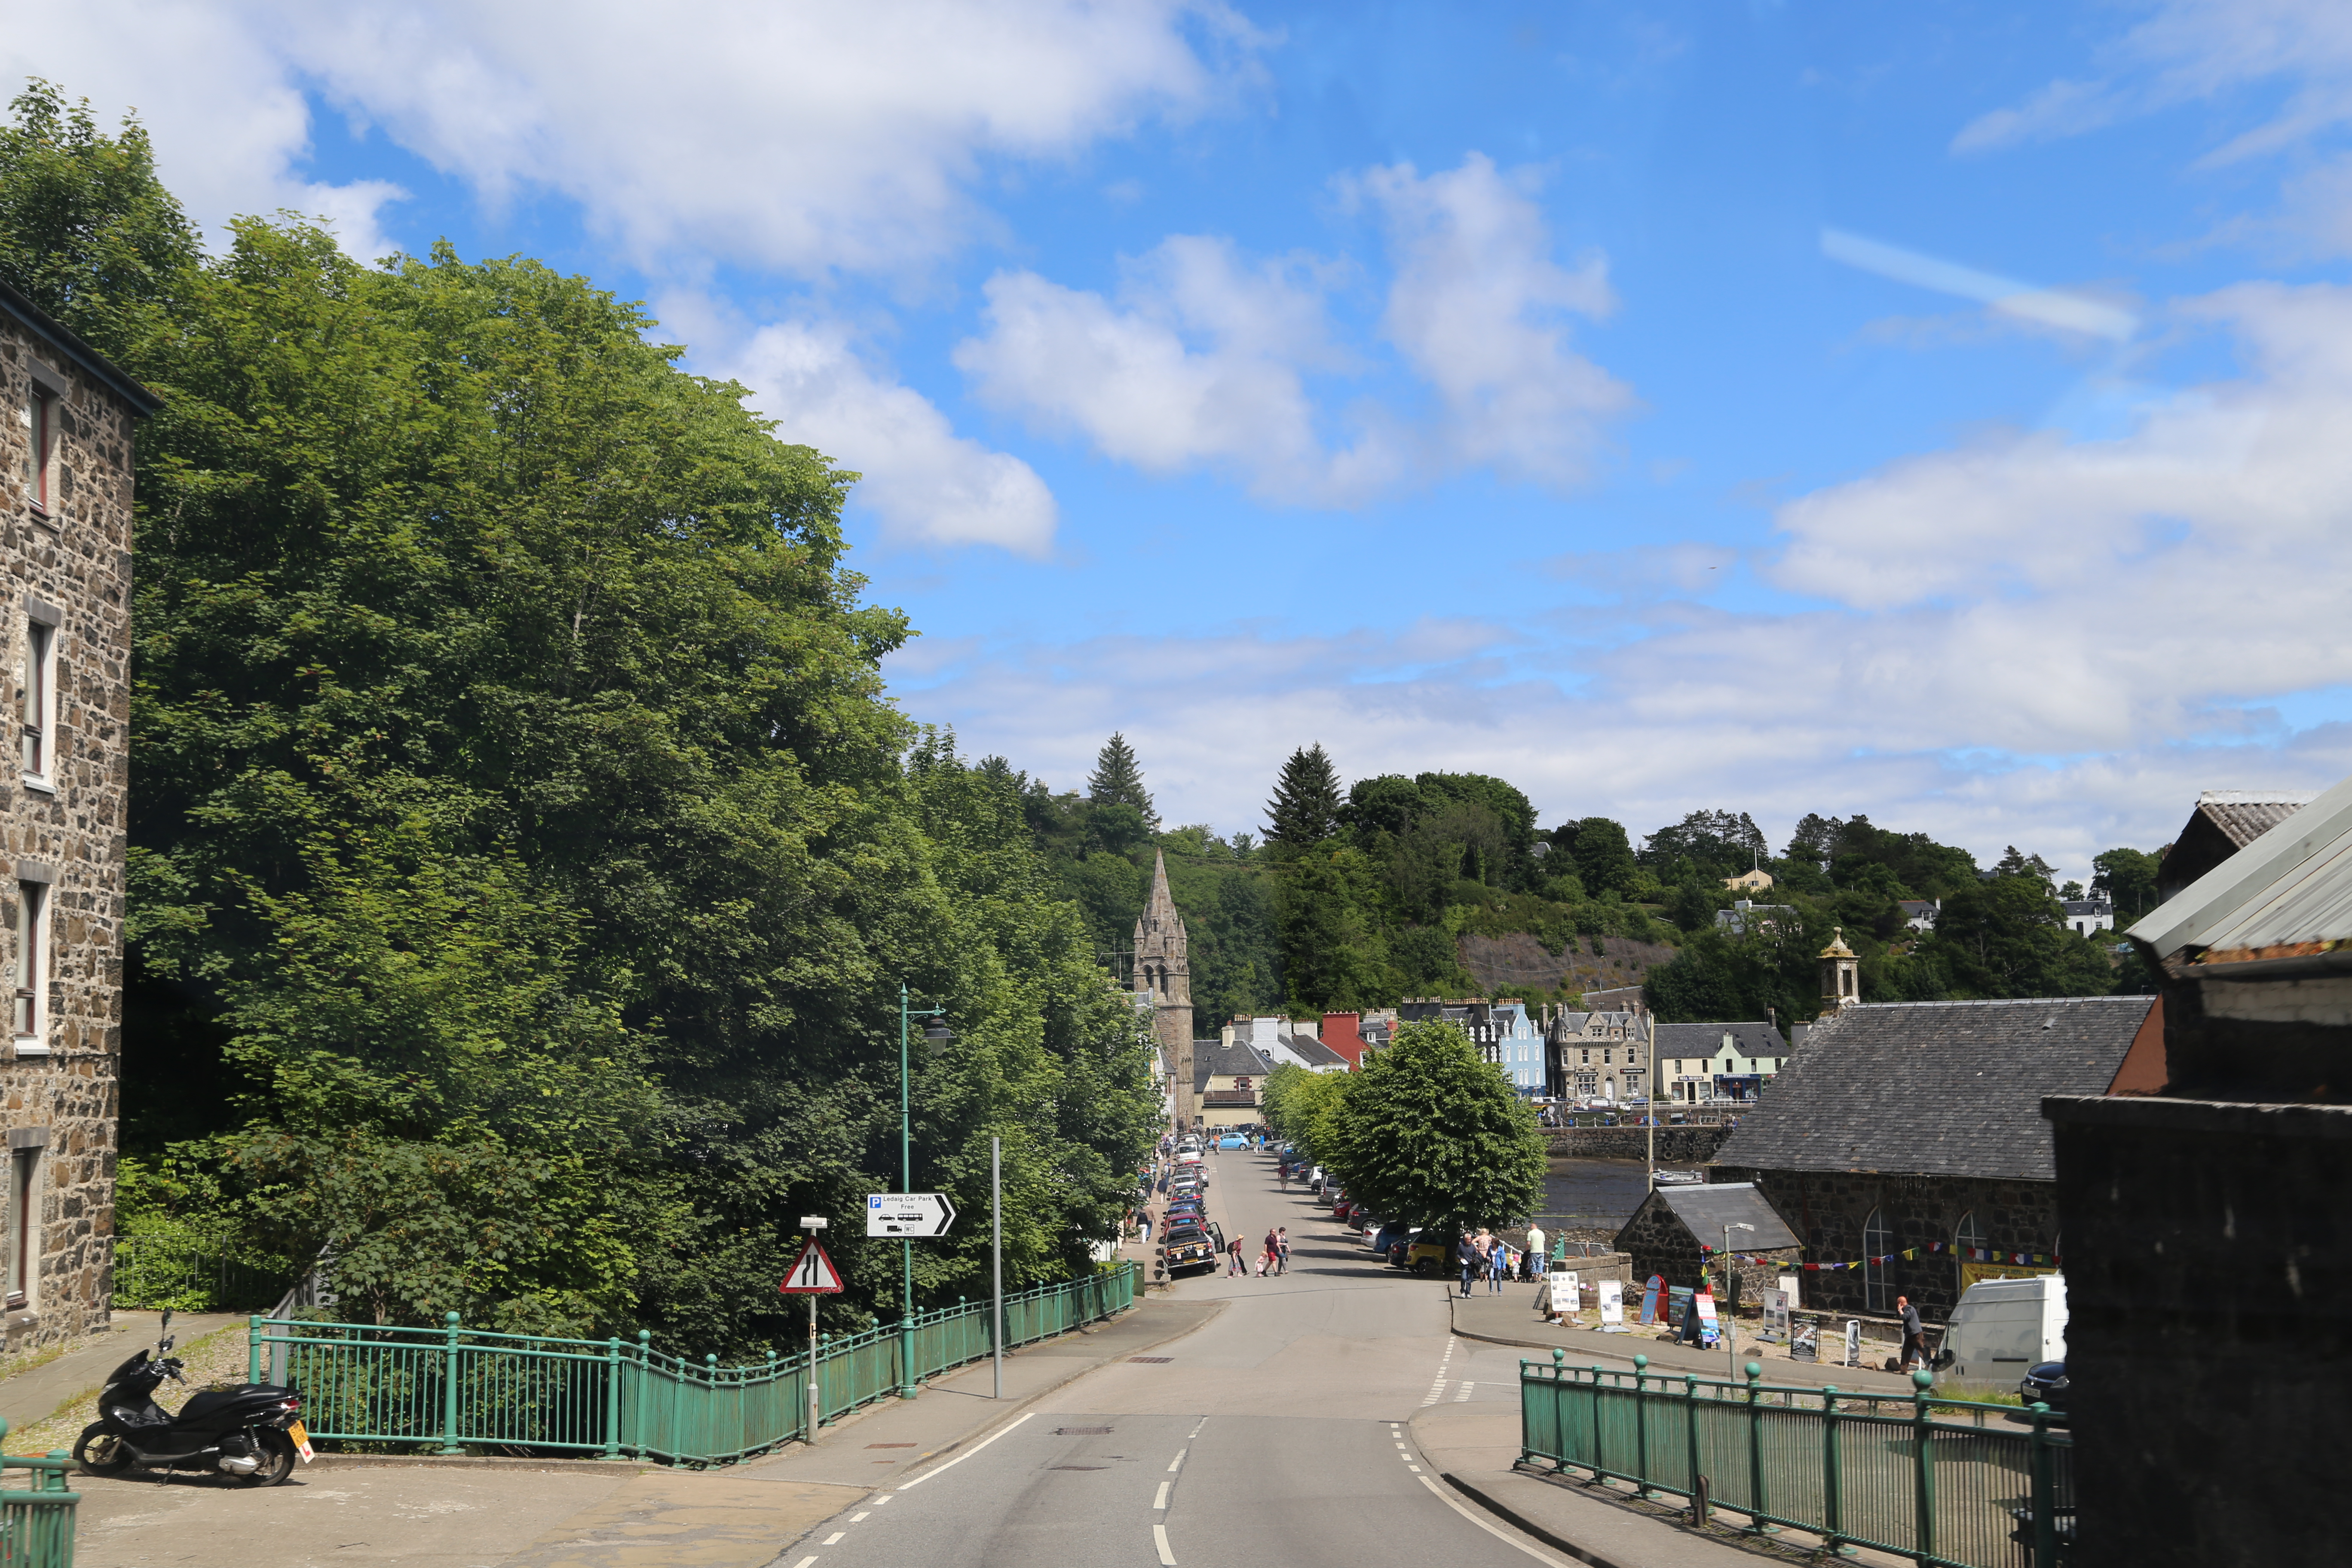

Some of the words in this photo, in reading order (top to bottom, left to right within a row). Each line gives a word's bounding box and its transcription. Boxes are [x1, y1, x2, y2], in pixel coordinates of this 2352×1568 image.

[872, 1198, 880, 1207] P
[1797, 1326, 1813, 1342] OPEN
[301, 1445, 310, 1457] L
